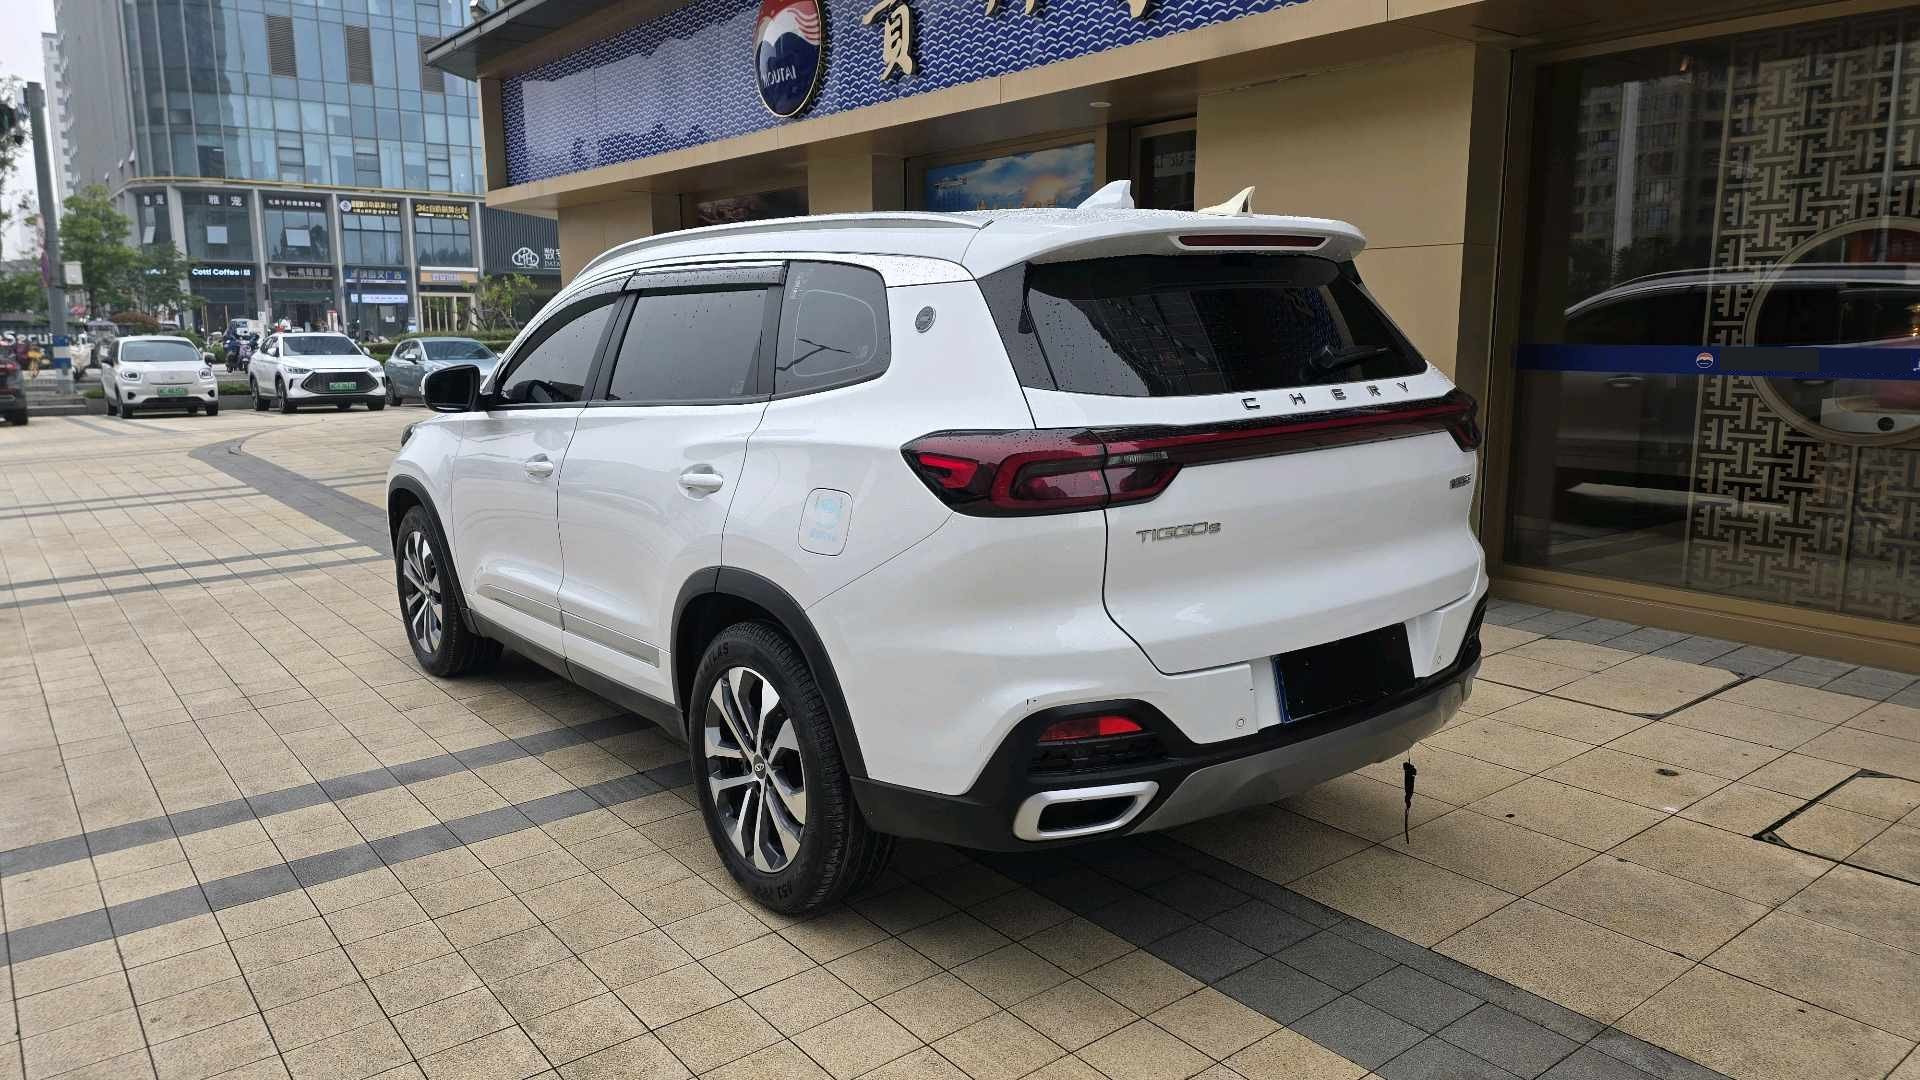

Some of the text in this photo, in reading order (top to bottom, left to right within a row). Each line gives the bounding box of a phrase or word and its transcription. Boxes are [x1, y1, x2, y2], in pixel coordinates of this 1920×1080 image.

[761, 64, 797, 88] MOUTAI
[192, 268, 211, 276] Cotti
[213, 268, 239, 276] Coffee
[1241, 380, 1409, 410] CHERY
